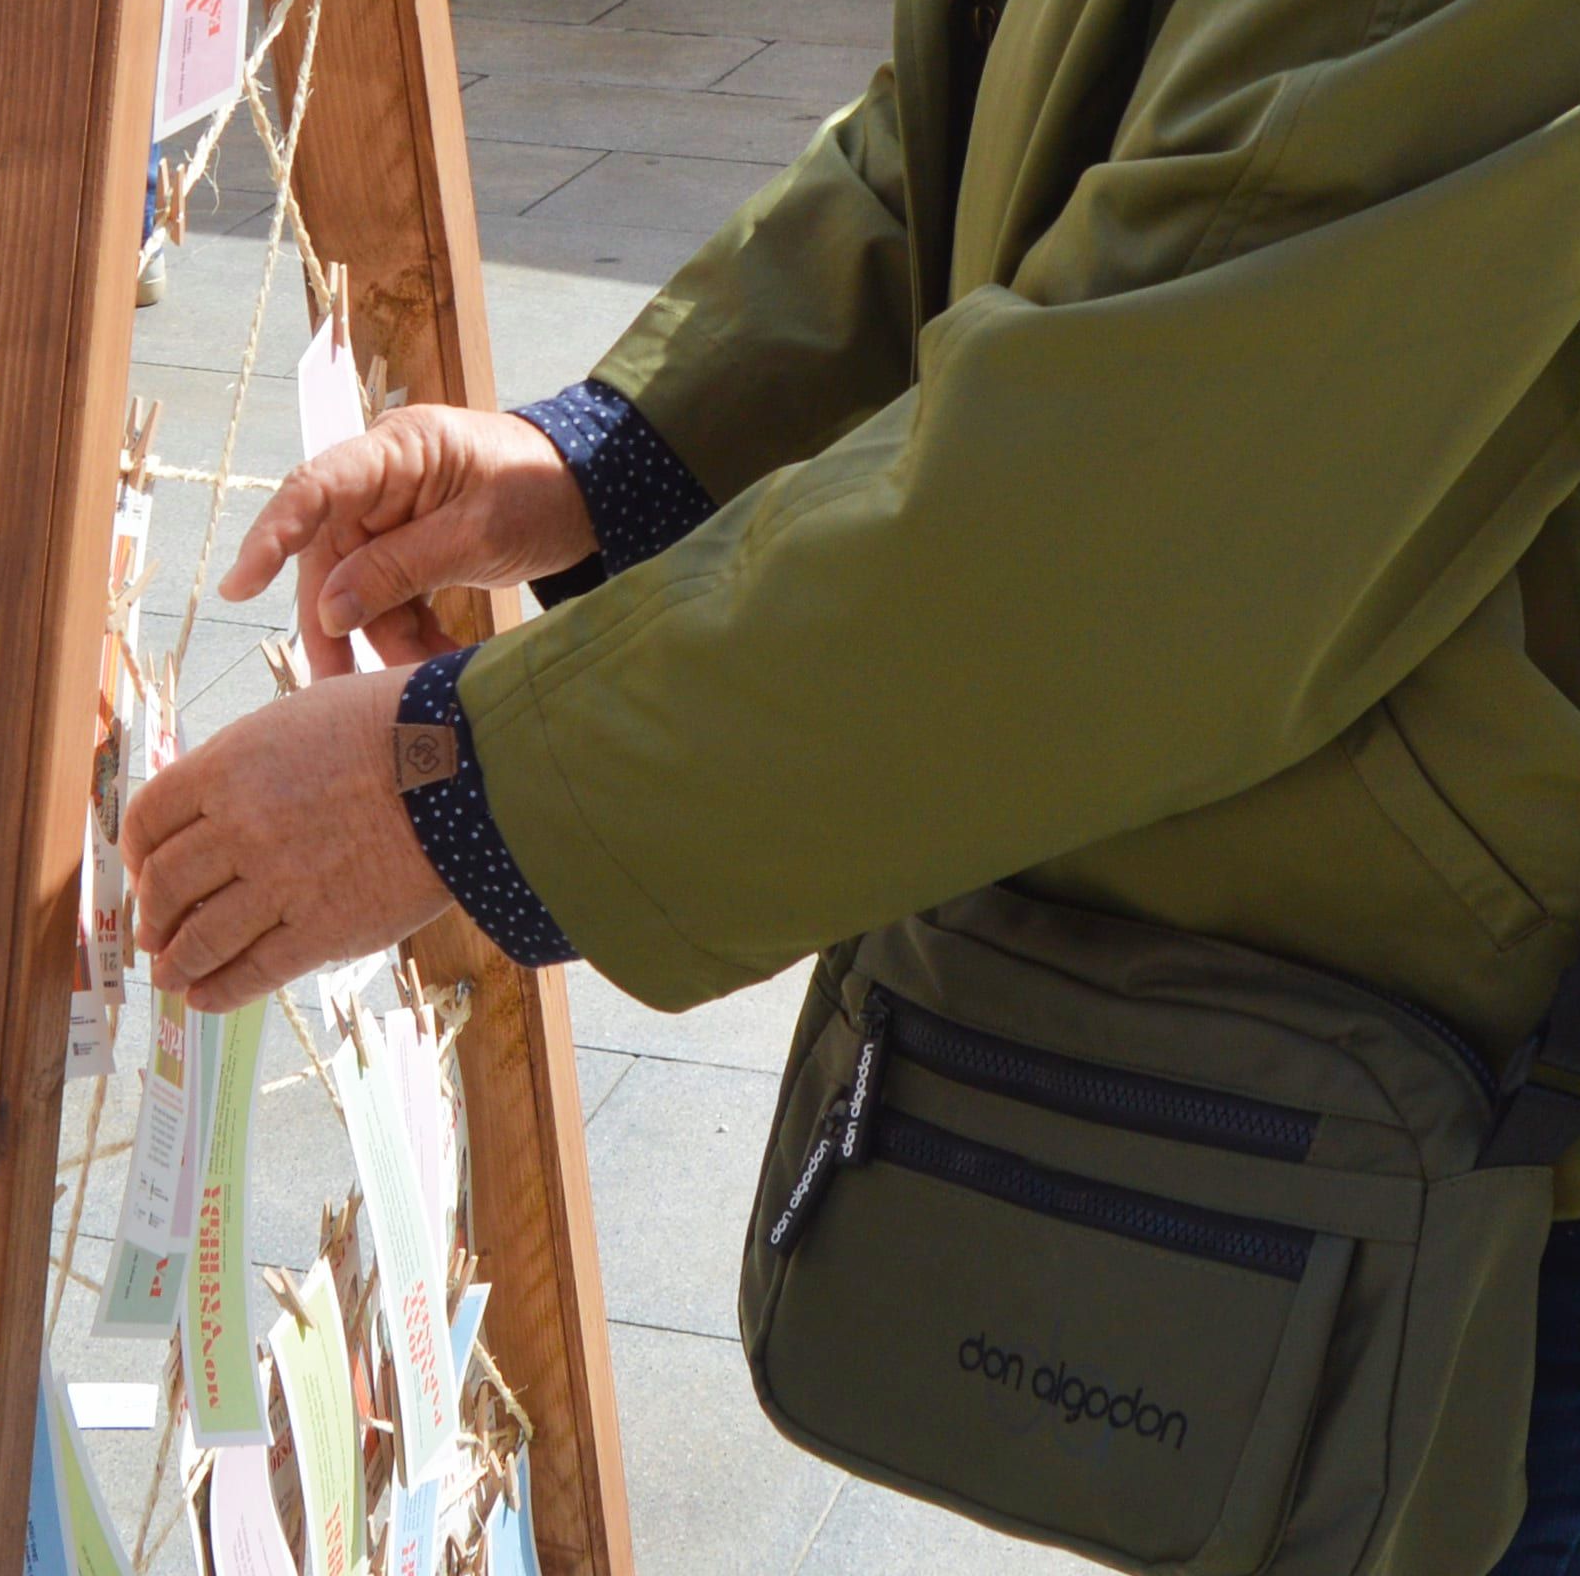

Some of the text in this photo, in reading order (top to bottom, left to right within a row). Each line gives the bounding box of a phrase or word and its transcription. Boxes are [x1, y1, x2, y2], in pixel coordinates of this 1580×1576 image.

[842, 1043, 874, 1157] don algodon
[770, 1139, 831, 1244] don algodon
[199, 1187, 219, 1409] MONTSERRAT
[958, 1331, 1188, 1451] don algodon
